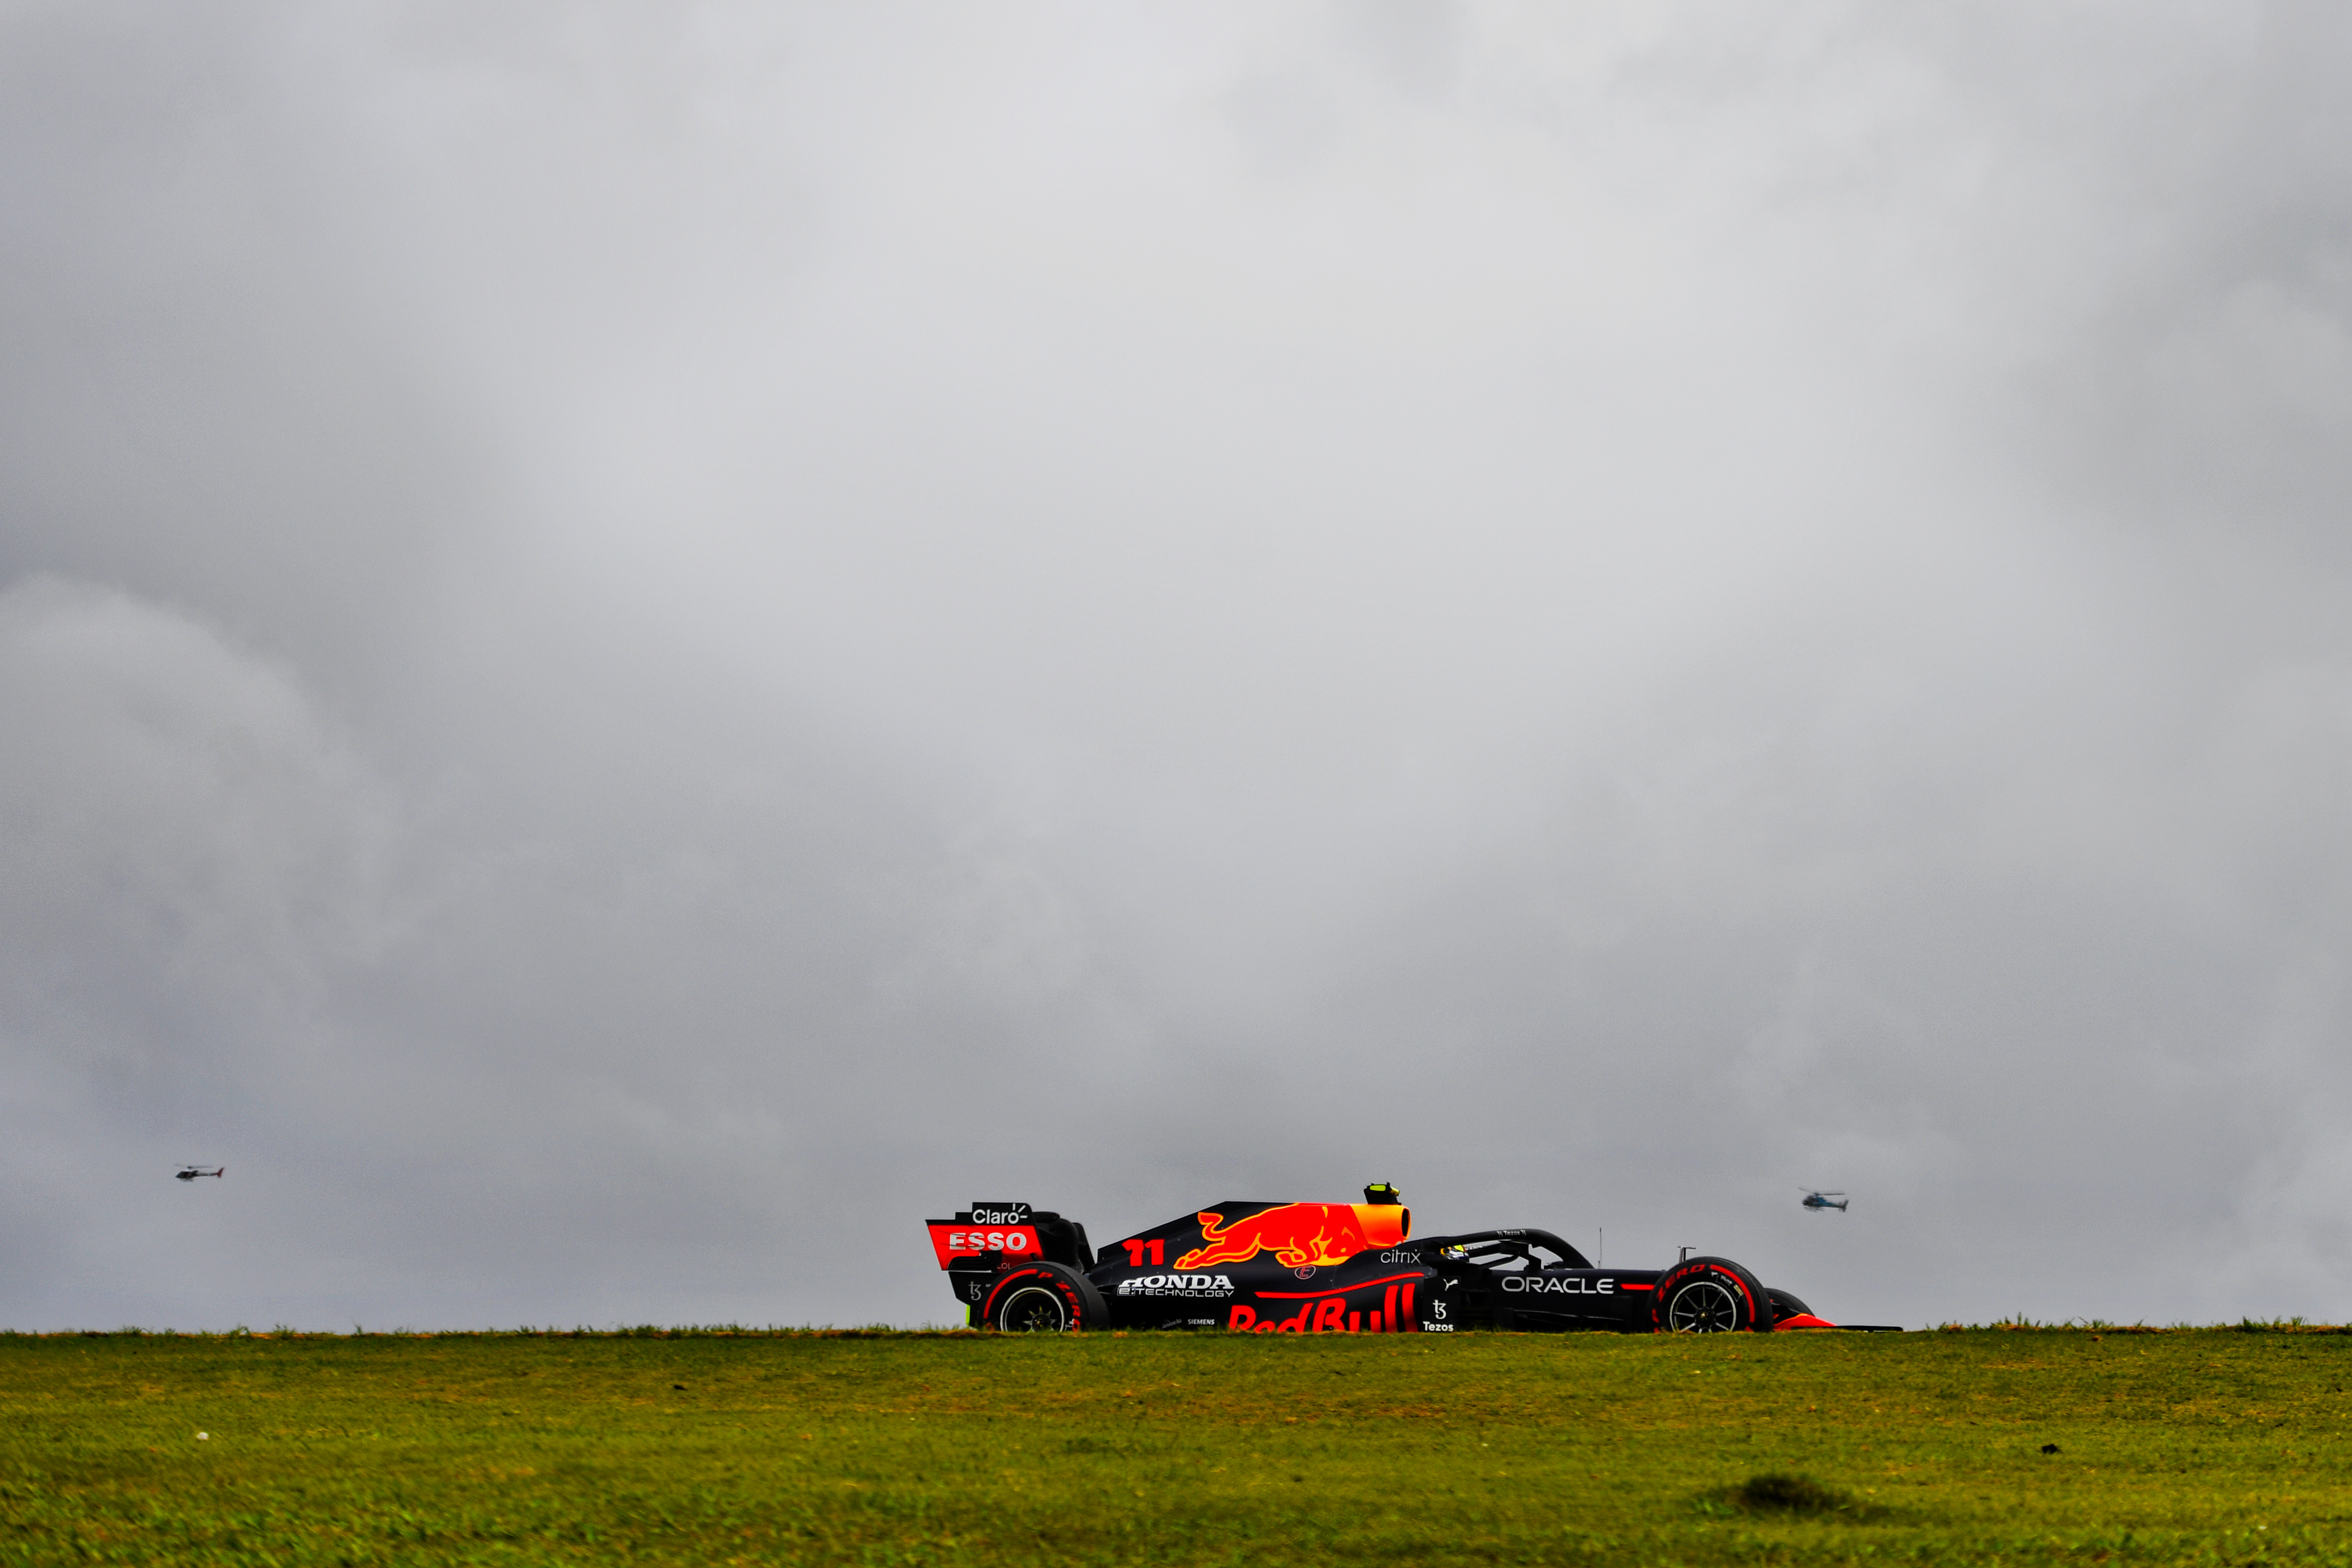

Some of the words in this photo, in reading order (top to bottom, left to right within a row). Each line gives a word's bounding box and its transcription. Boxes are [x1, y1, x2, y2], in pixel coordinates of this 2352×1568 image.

[973, 1209, 1019, 1224] Claro
[949, 1232, 1026, 1250] ESSO
[1122, 1239, 1164, 1266] 11
[1381, 1249, 1421, 1263] citrix
[1119, 1275, 1234, 1289] HONDA
[1502, 1277, 1614, 1294] ORACLE
[1423, 1321, 1454, 1332] Tezos
